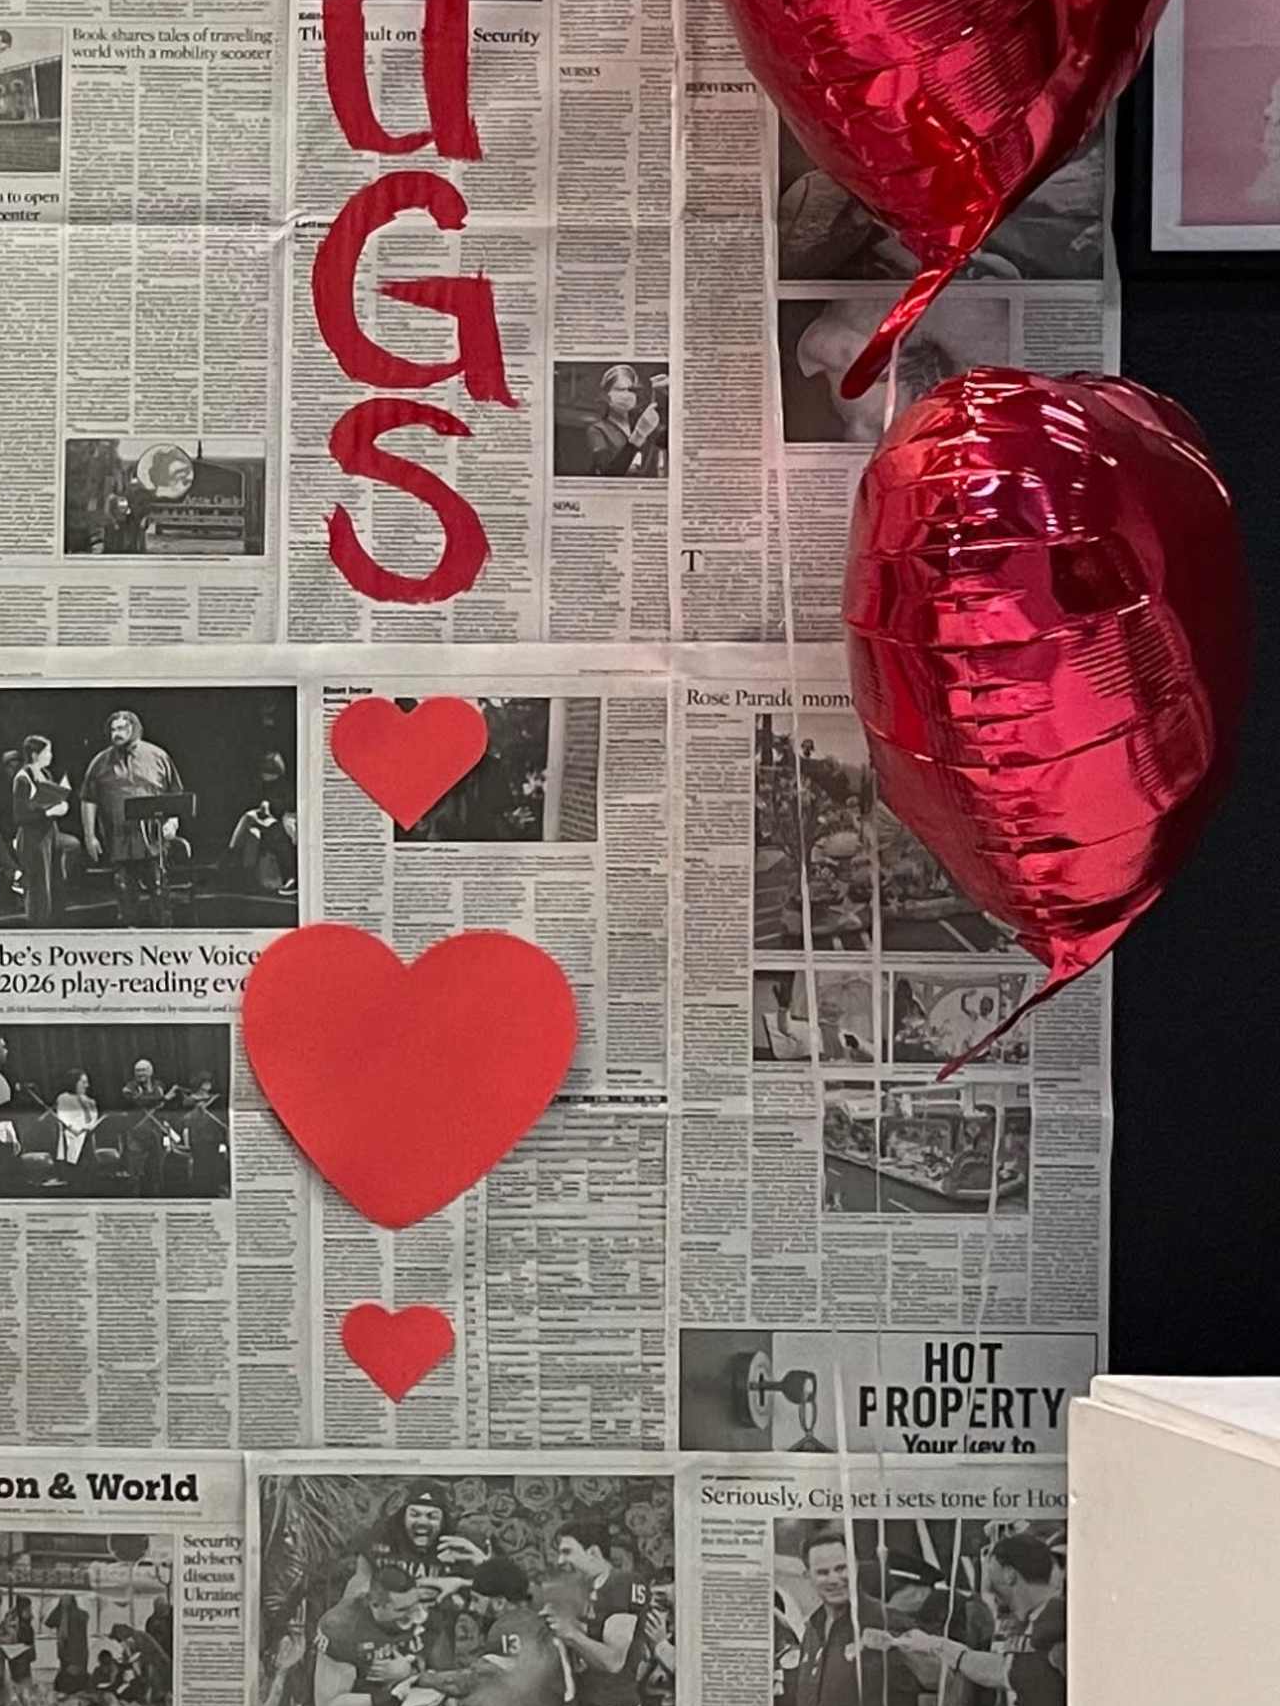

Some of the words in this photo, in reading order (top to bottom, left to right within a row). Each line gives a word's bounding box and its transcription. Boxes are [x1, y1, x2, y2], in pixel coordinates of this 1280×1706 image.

[49, 946, 133, 966] Powers
[141, 945, 192, 966] New
[0, 974, 55, 993] 2026
[61, 970, 209, 999] play-reading
[925, 1342, 1003, 1384] HOT
[48, 1473, 77, 1499] &
[86, 1473, 199, 1502] World
[501, 1634, 521, 1655] 13
